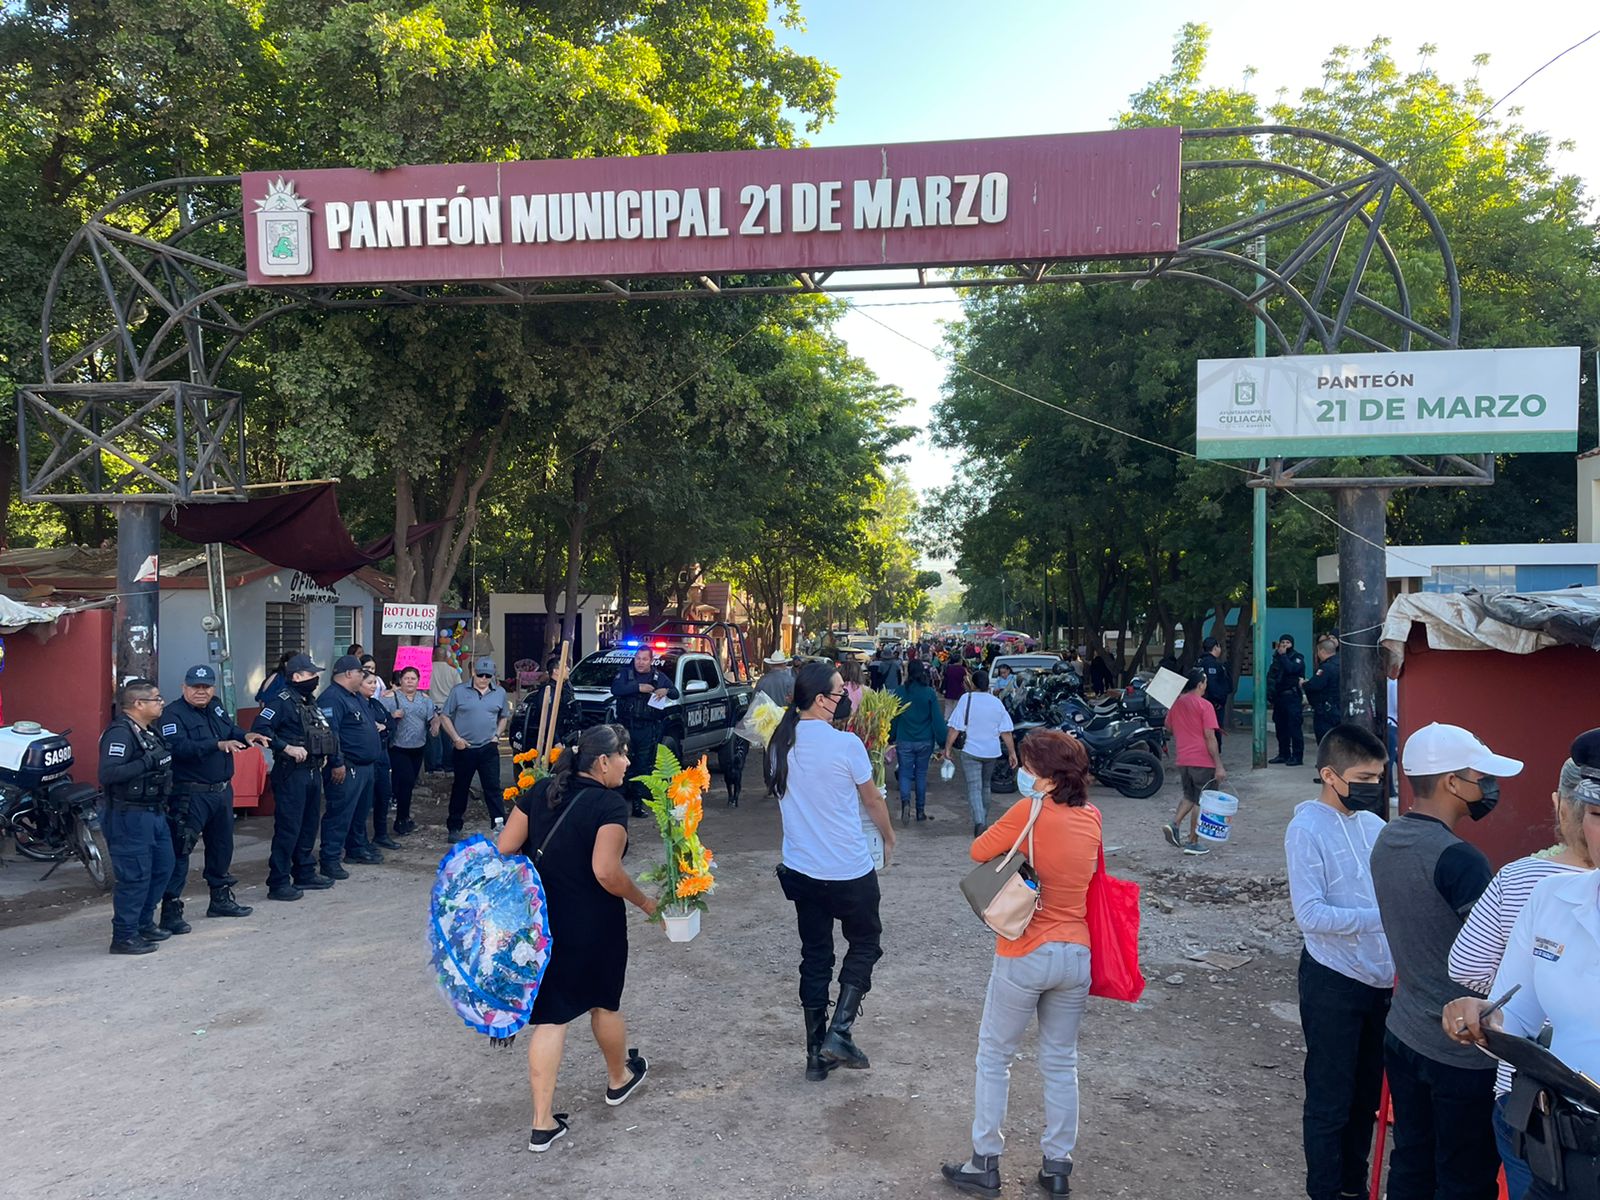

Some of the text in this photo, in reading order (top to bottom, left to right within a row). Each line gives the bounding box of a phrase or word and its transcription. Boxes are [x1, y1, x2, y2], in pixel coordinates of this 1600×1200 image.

[325, 172, 1009, 250] PANTEÓN MUNICIPAL 21 DE MARZO
[1317, 370, 1414, 390] PANTEÓN
[1316, 394, 1547, 422] 21 DE MARZO
[384, 606, 435, 618] ROTULOS
